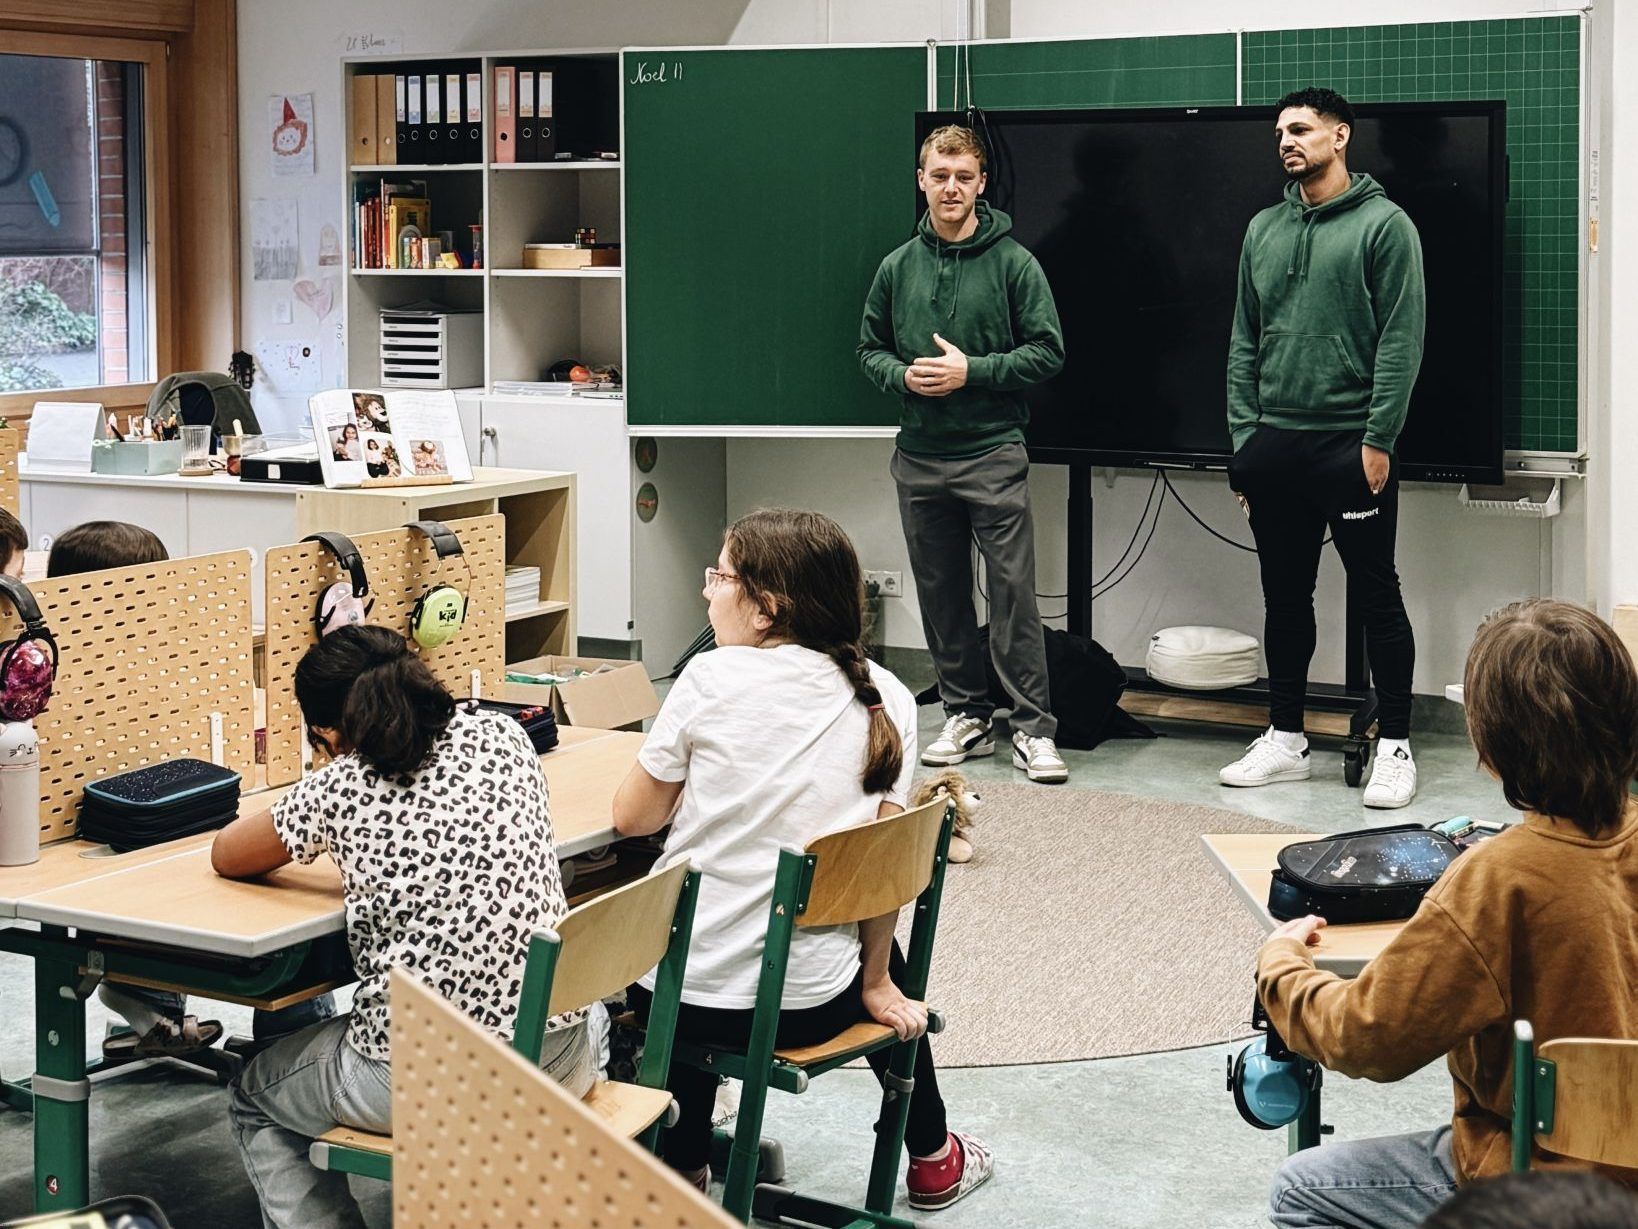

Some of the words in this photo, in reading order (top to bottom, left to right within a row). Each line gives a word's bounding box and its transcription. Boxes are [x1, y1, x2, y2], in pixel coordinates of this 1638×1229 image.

[630, 62, 667, 85] Noel
[1342, 507, 1379, 520] uhlsport
[439, 609, 457, 622] kid
[49, 1177, 58, 1191] 4
